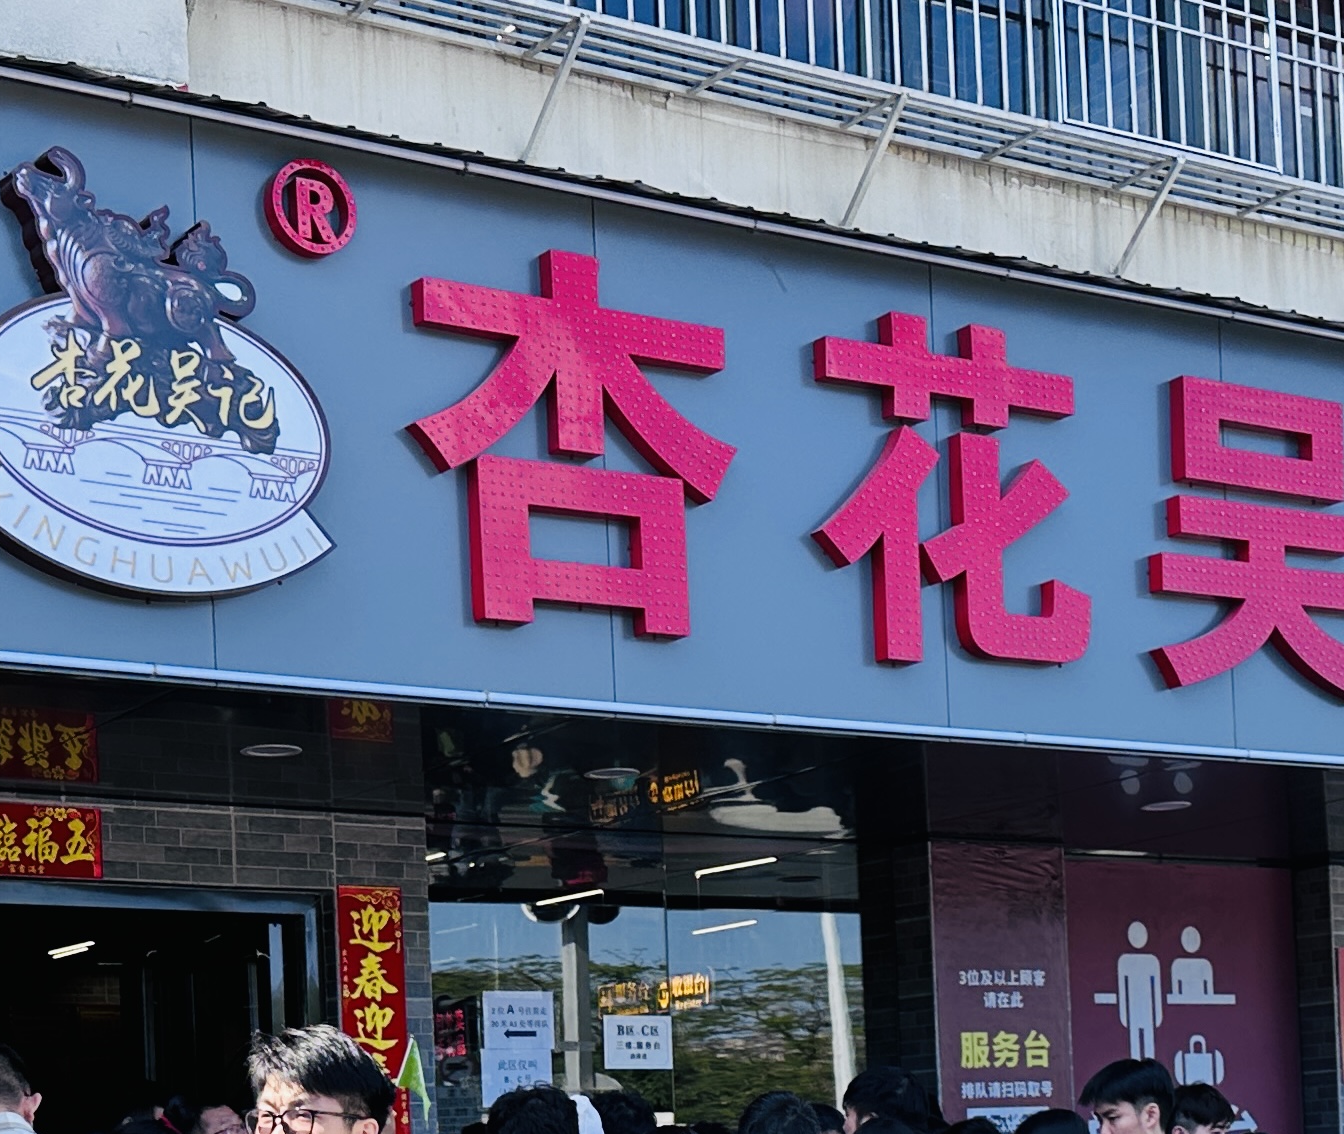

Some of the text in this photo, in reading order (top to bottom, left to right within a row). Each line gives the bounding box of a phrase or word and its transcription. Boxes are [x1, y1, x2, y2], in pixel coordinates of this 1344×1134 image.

[30, 330, 279, 433] 杏花吴记
[959, 969, 1046, 986] 3位及以上顾客
[983, 991, 1024, 1009] 请在此
[960, 1029, 1051, 1069] 服务台
[961, 1080, 1054, 1100] 排队请扫码取号
